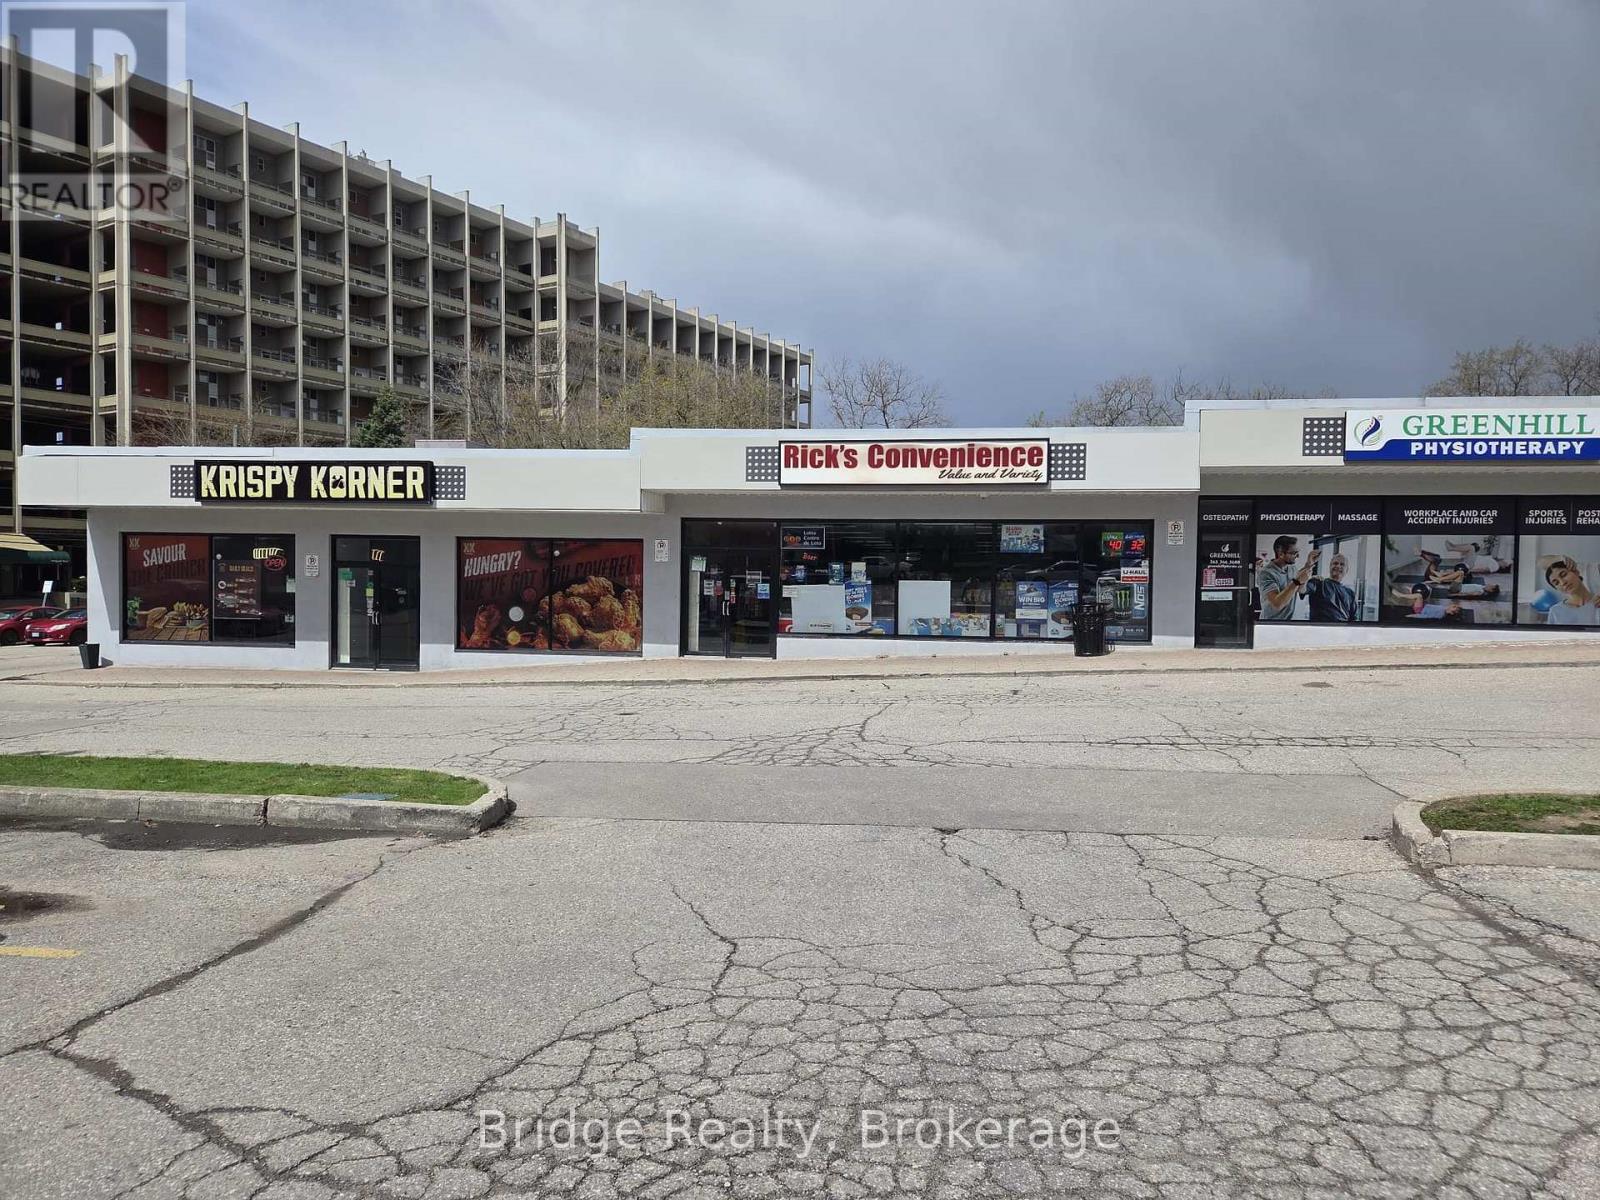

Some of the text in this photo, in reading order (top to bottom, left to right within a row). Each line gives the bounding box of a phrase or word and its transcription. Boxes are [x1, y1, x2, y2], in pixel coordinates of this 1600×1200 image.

[1402, 414, 1595, 436] GREENHILL
[1410, 441, 1585, 455] PHYSIOTHERAPY
[783, 443, 1044, 469] Rick's Convenience
[938, 468, 1043, 481] Value and Variety
[200, 465, 425, 499] KRISPY KORNER
[1260, 513, 1326, 521] PHYSIOTHERAPY
[1337, 513, 1378, 521] MASSAGE
[1404, 509, 1498, 517] WORKPLACE AND CAR
[1528, 509, 1564, 517] SPORTS
[1407, 516, 1494, 524] ACCIDENT INJURIES
[1525, 517, 1567, 525] INJURIES
[143, 543, 186, 567] SAVOUR
[265, 557, 286, 569] OPEN
[463, 550, 522, 577] HUNGRY?
[1133, 583, 1145, 611] NOS
